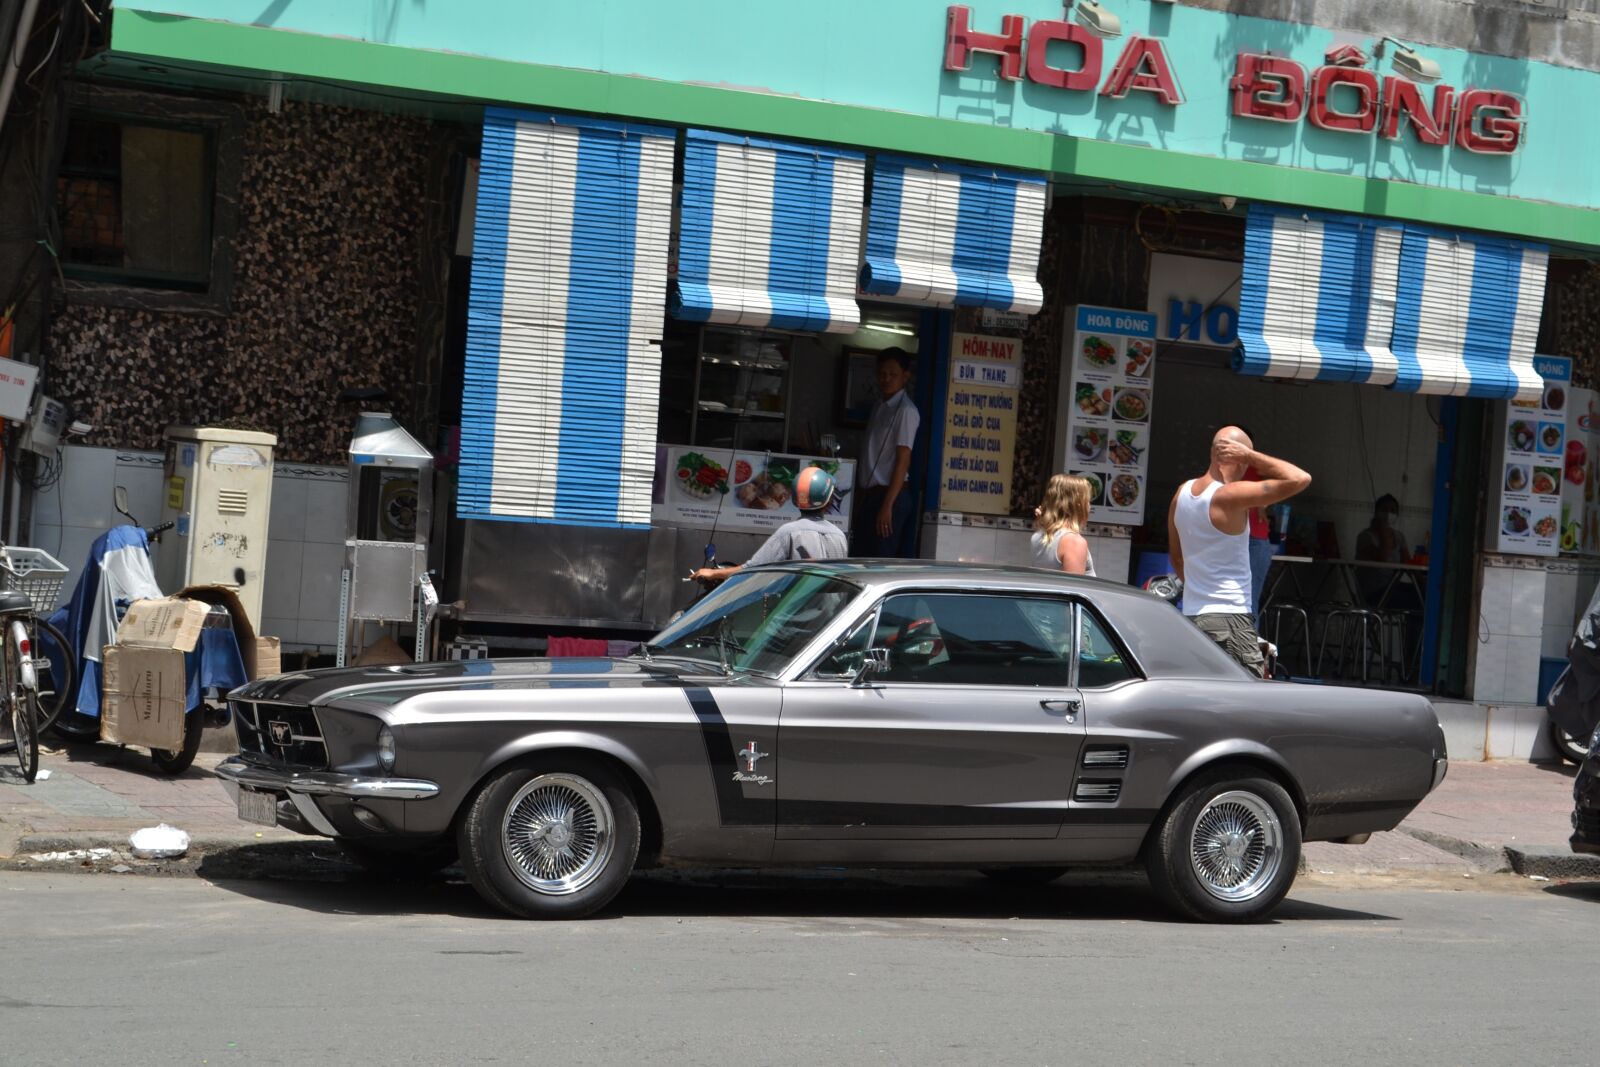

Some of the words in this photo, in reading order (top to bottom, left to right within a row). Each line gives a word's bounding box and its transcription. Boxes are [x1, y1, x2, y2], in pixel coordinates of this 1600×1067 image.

[945, 4, 1186, 106] HOA
[1087, 313, 1112, 328] HOA
[981, 367, 1007, 382] THANG
[986, 417, 1001, 431] CUA
[986, 439, 1001, 453] CUA
[985, 460, 999, 474] CUA
[969, 479, 989, 494] CANH
[990, 481, 1004, 495] CUA
[143, 670, 153, 721] Marlboro
[732, 771, 774, 786] Mustang
